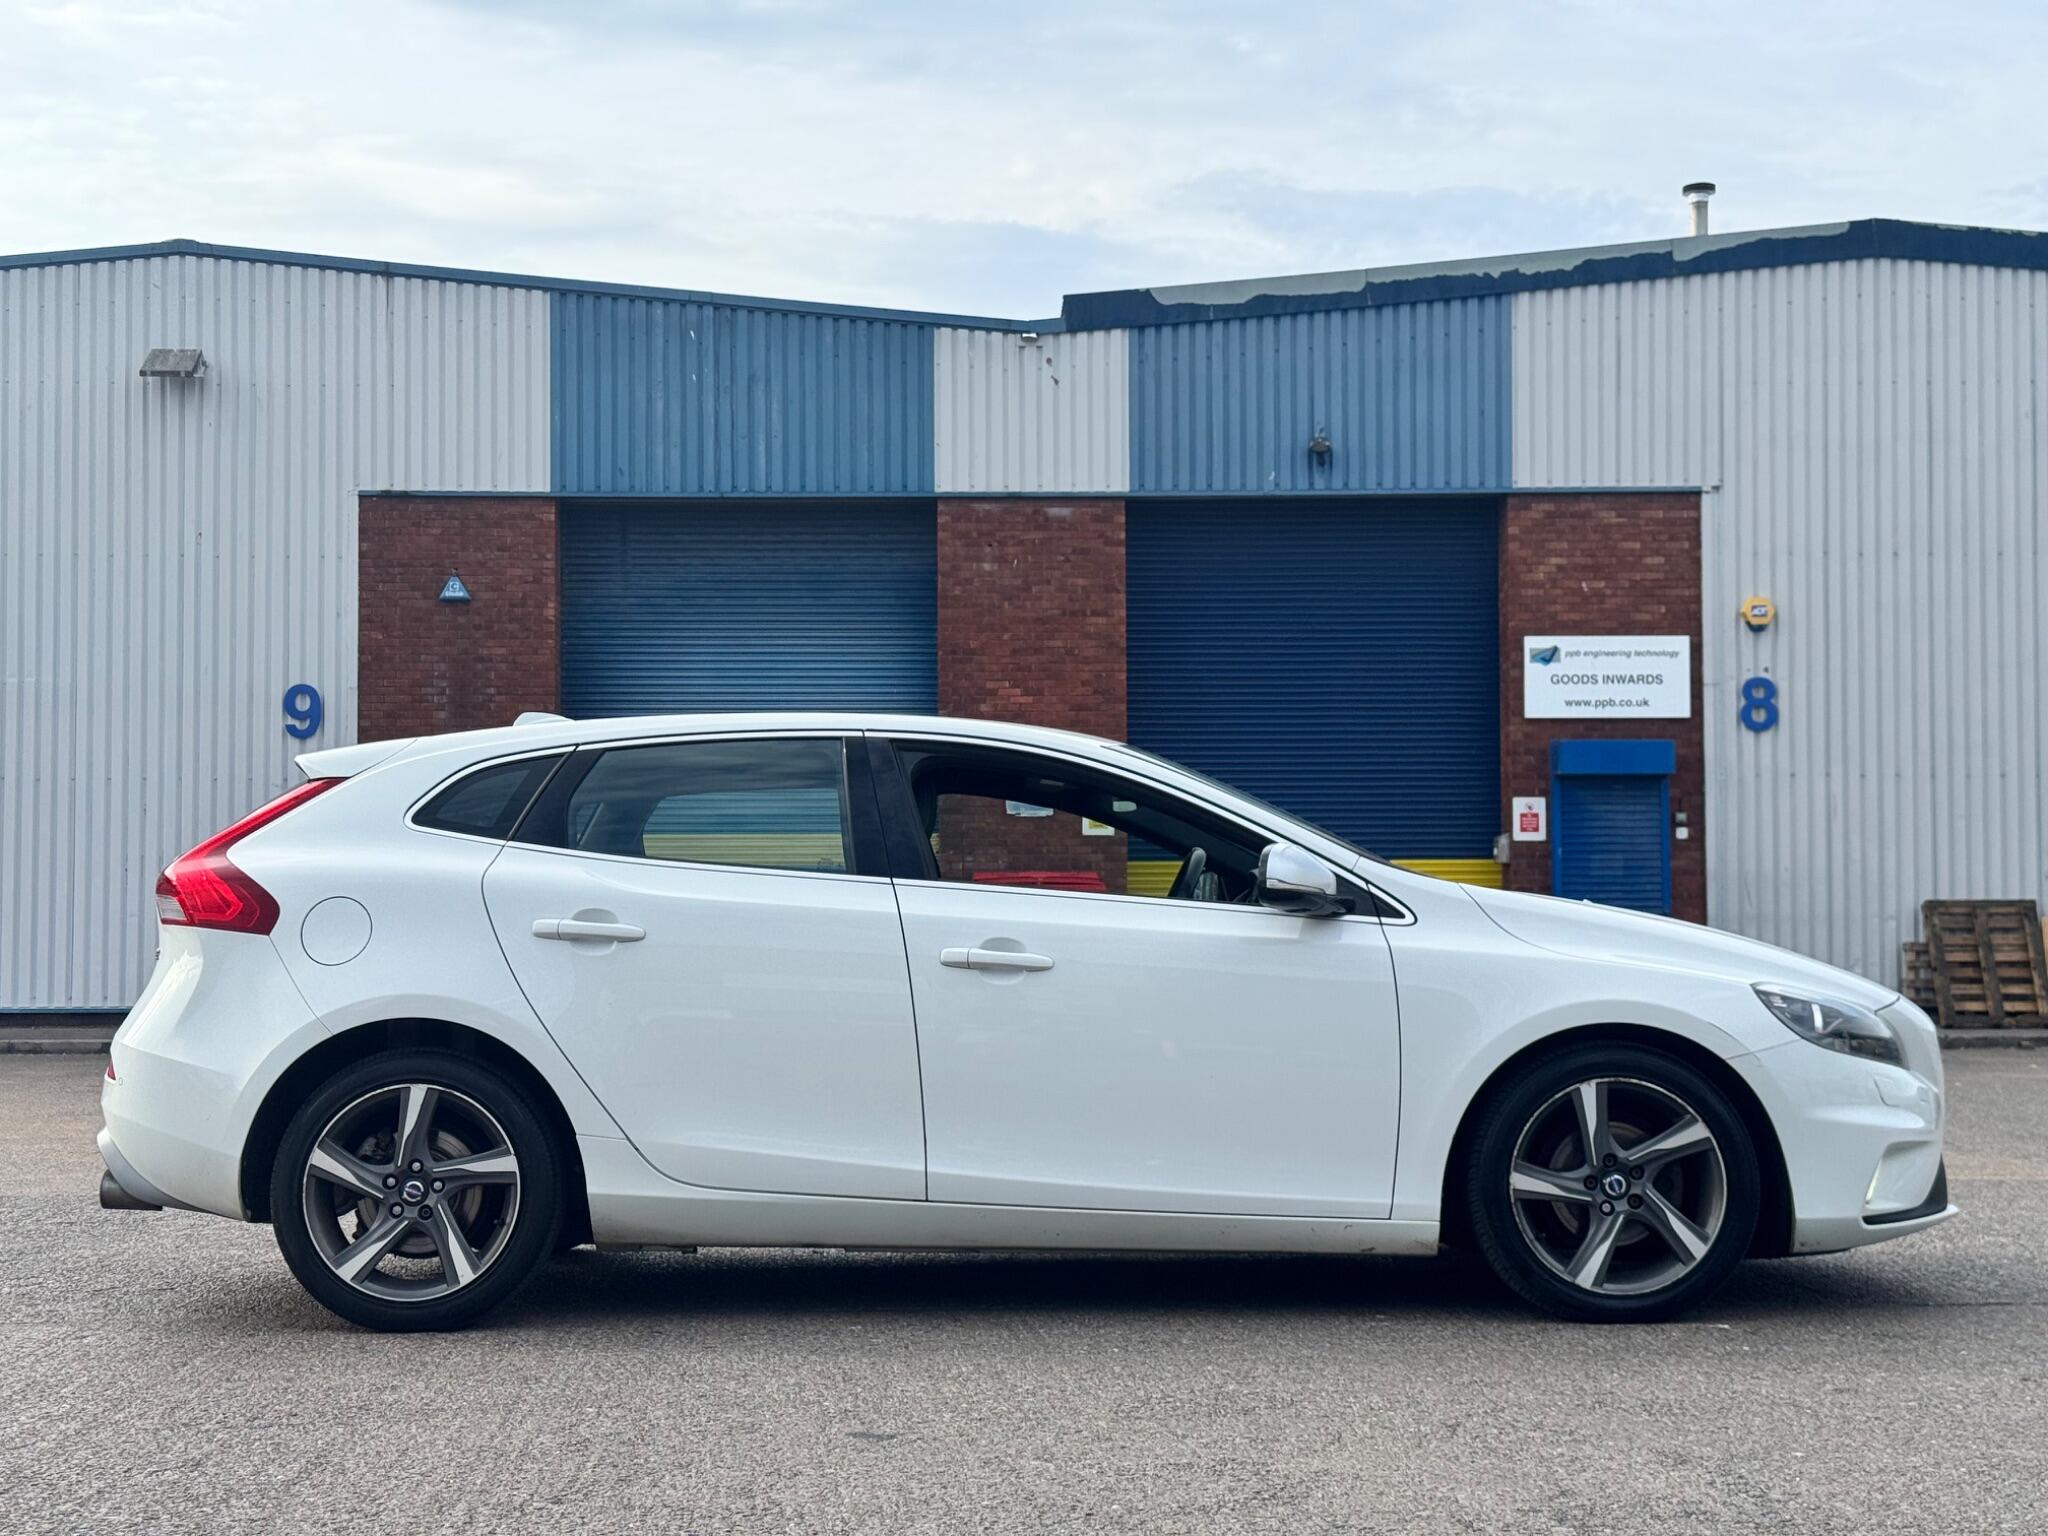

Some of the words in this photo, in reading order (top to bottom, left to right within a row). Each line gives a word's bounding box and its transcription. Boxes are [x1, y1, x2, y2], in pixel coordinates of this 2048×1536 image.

[1564, 649, 1581, 658] ppb
[1583, 649, 1632, 659] engineering
[1633, 649, 1680, 659] technology
[1550, 673, 1599, 686] GOODS
[1602, 673, 1664, 686] INWARDS
[1564, 697, 1651, 710] www.ppb.co.uk
[1741, 676, 1779, 732] 8
[283, 683, 322, 740] 9
